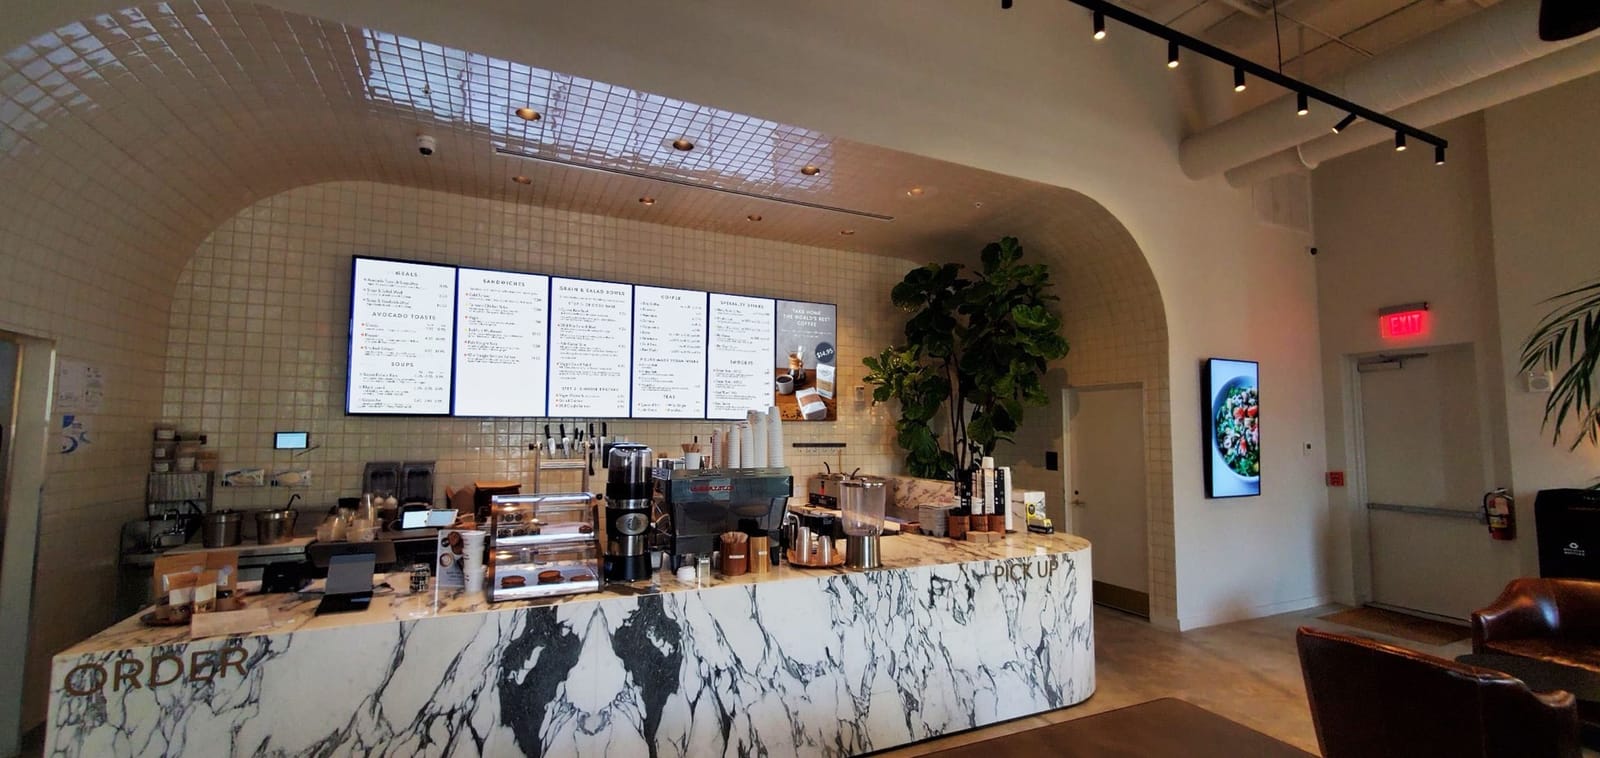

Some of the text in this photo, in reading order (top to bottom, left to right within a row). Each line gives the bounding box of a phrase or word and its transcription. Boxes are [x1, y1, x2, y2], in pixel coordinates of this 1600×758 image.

[483, 279, 526, 287] SANDWICHES
[372, 311, 408, 319] AVOCADO
[1391, 314, 1420, 336] EXIT
[816, 348, 834, 359] $14.95
[994, 560, 1059, 584] PICK UP
[64, 646, 249, 697] ORDER
